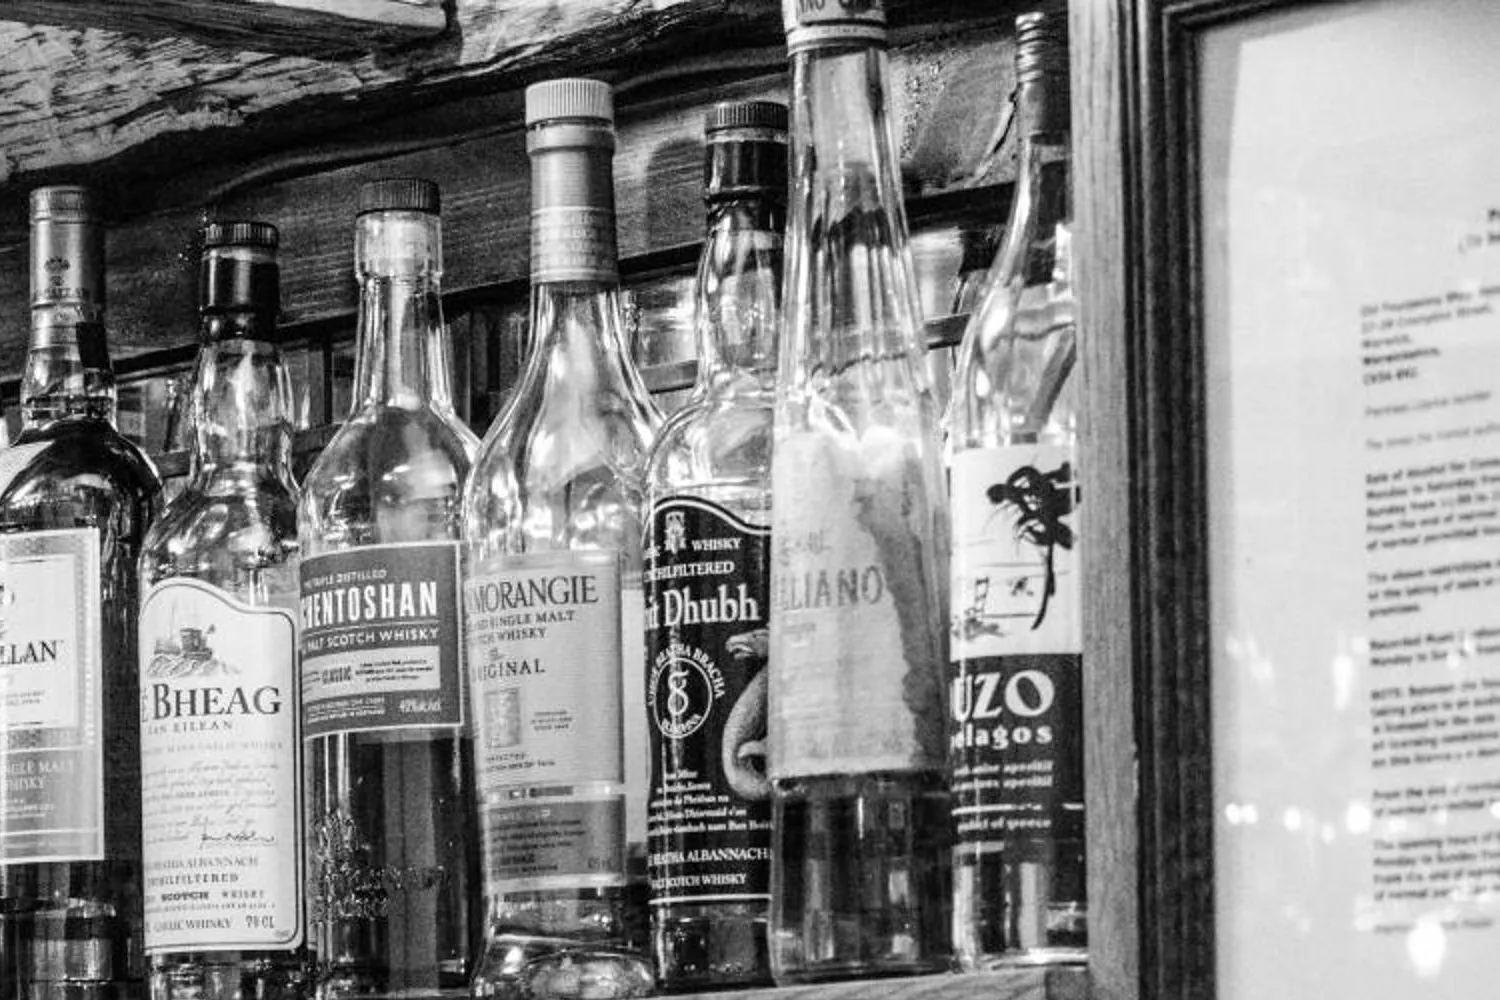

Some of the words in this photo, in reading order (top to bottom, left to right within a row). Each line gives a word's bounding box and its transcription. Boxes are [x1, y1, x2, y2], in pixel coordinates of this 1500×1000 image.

[691, 537, 742, 552] WHISKY
[662, 583, 762, 628] Dhubh
[535, 610, 575, 624] MALT
[379, 627, 439, 643] WHISKY
[152, 683, 283, 720] BHEAG
[686, 847, 768, 862] ALBANNACH
